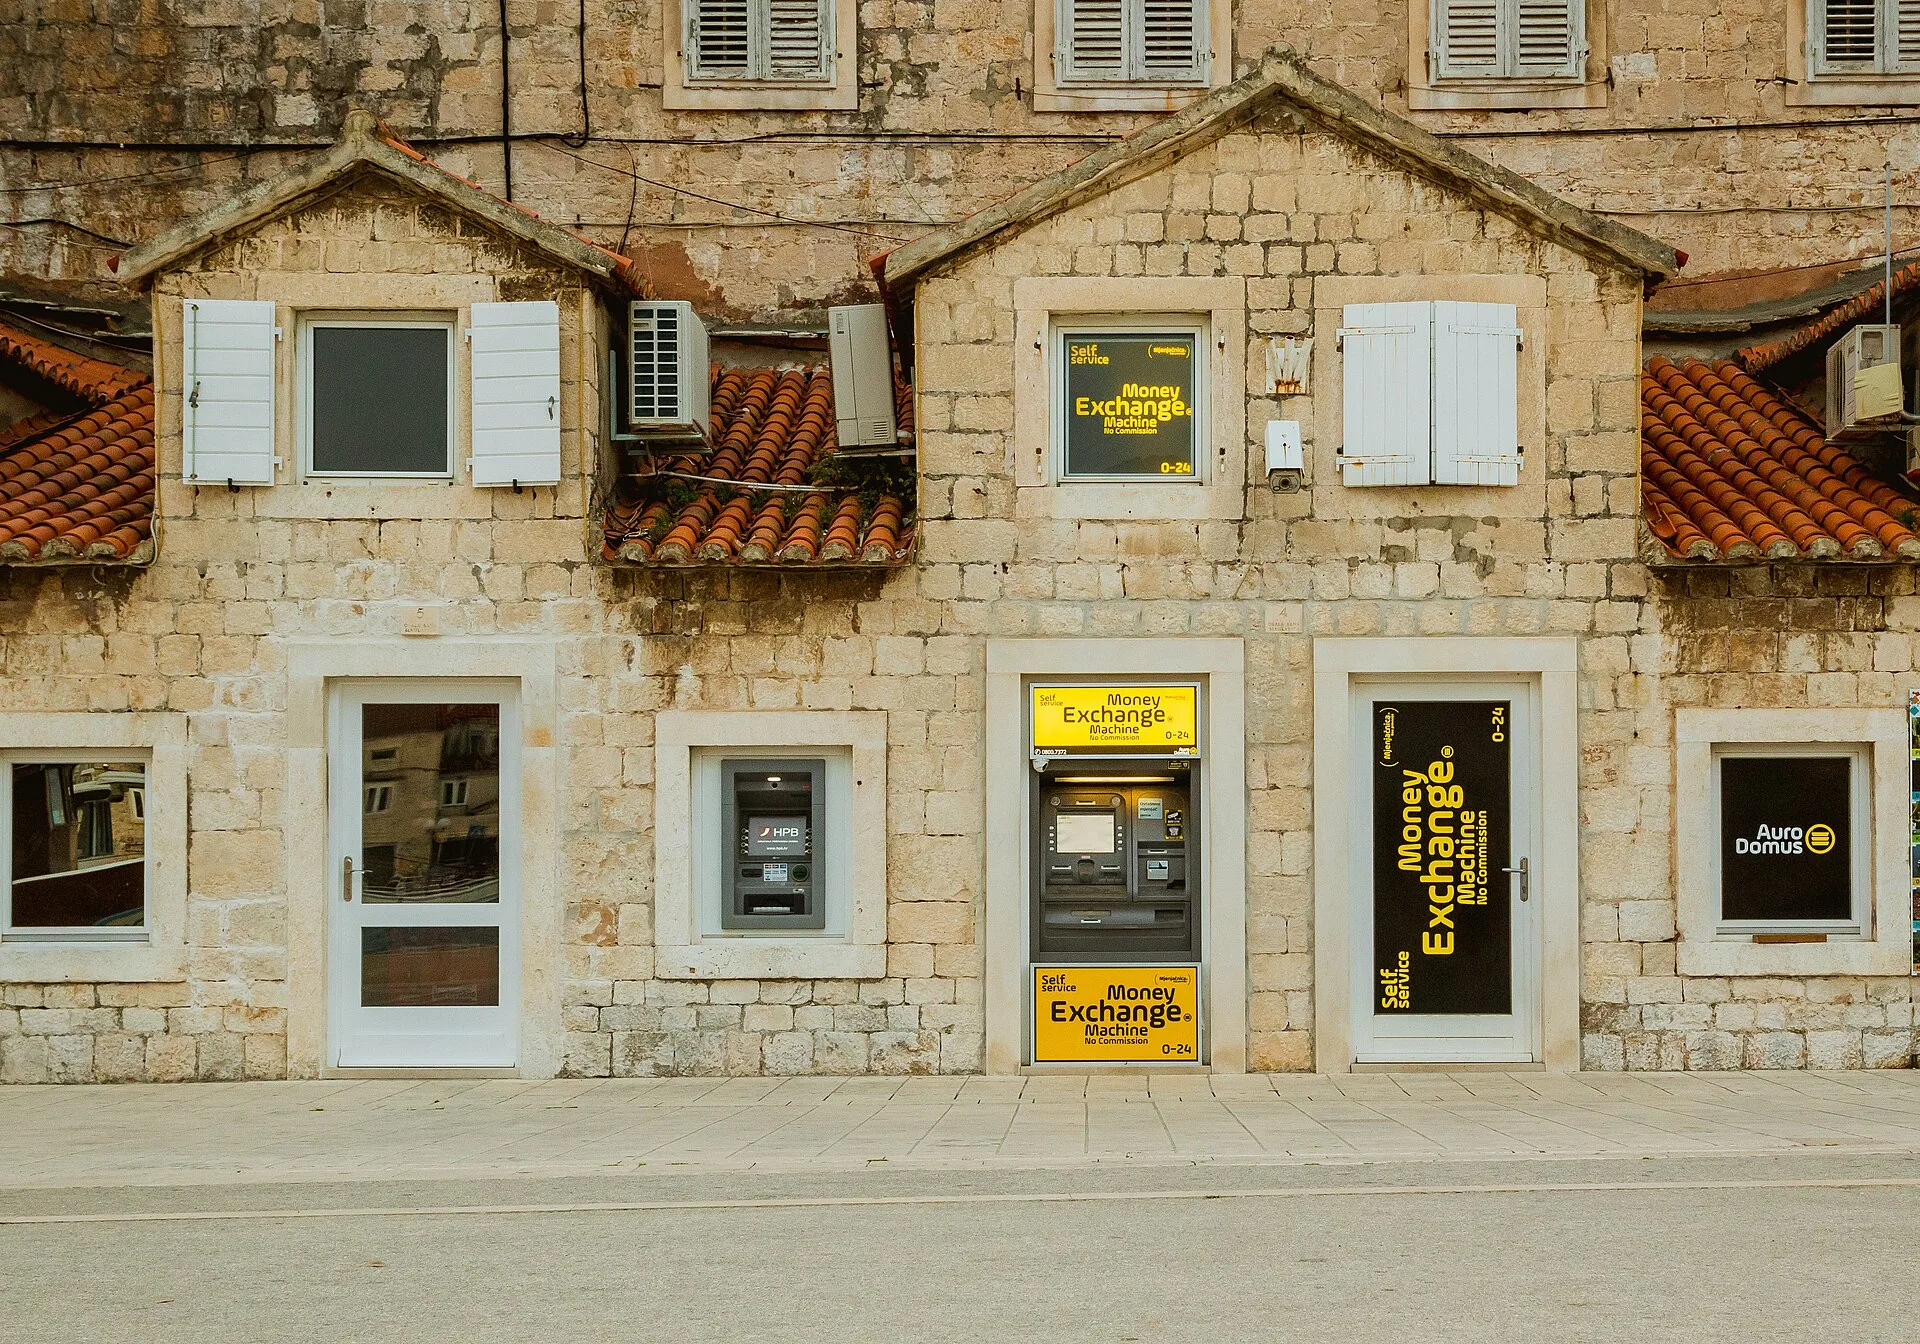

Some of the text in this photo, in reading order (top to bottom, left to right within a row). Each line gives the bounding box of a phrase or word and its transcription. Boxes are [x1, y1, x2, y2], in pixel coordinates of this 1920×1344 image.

[1071, 345, 1097, 356] Self
[1071, 355, 1109, 364] service
[1122, 384, 1180, 401] Money
[1104, 416, 1158, 428] Machine
[1160, 462, 1191, 473] 0-24
[417, 608, 424, 618] 5
[1107, 694, 1160, 709] Money
[1064, 706, 1165, 727] Exchange
[1090, 724, 1140, 734] Machine
[1492, 707, 1504, 742] 0-24
[1166, 731, 1189, 739] 0-24
[1398, 769, 1429, 872] Money
[773, 828, 798, 836] HPB
[1756, 824, 1803, 840] Auro
[1736, 838, 1803, 854] Domus
[1420, 761, 1464, 955] Exchange
[1455, 811, 1475, 905] Machine
[1476, 810, 1488, 905] No Commission
[1042, 974, 1065, 985] Self
[1395, 951, 1410, 1008] service
[1042, 983, 1076, 992] service
[1107, 984, 1175, 1004] Money
[1380, 969, 1398, 1008] Self
[1051, 1000, 1181, 1028] Exchange
[1085, 1023, 1148, 1036] Machine
[1162, 1044, 1191, 1054] 0-24
